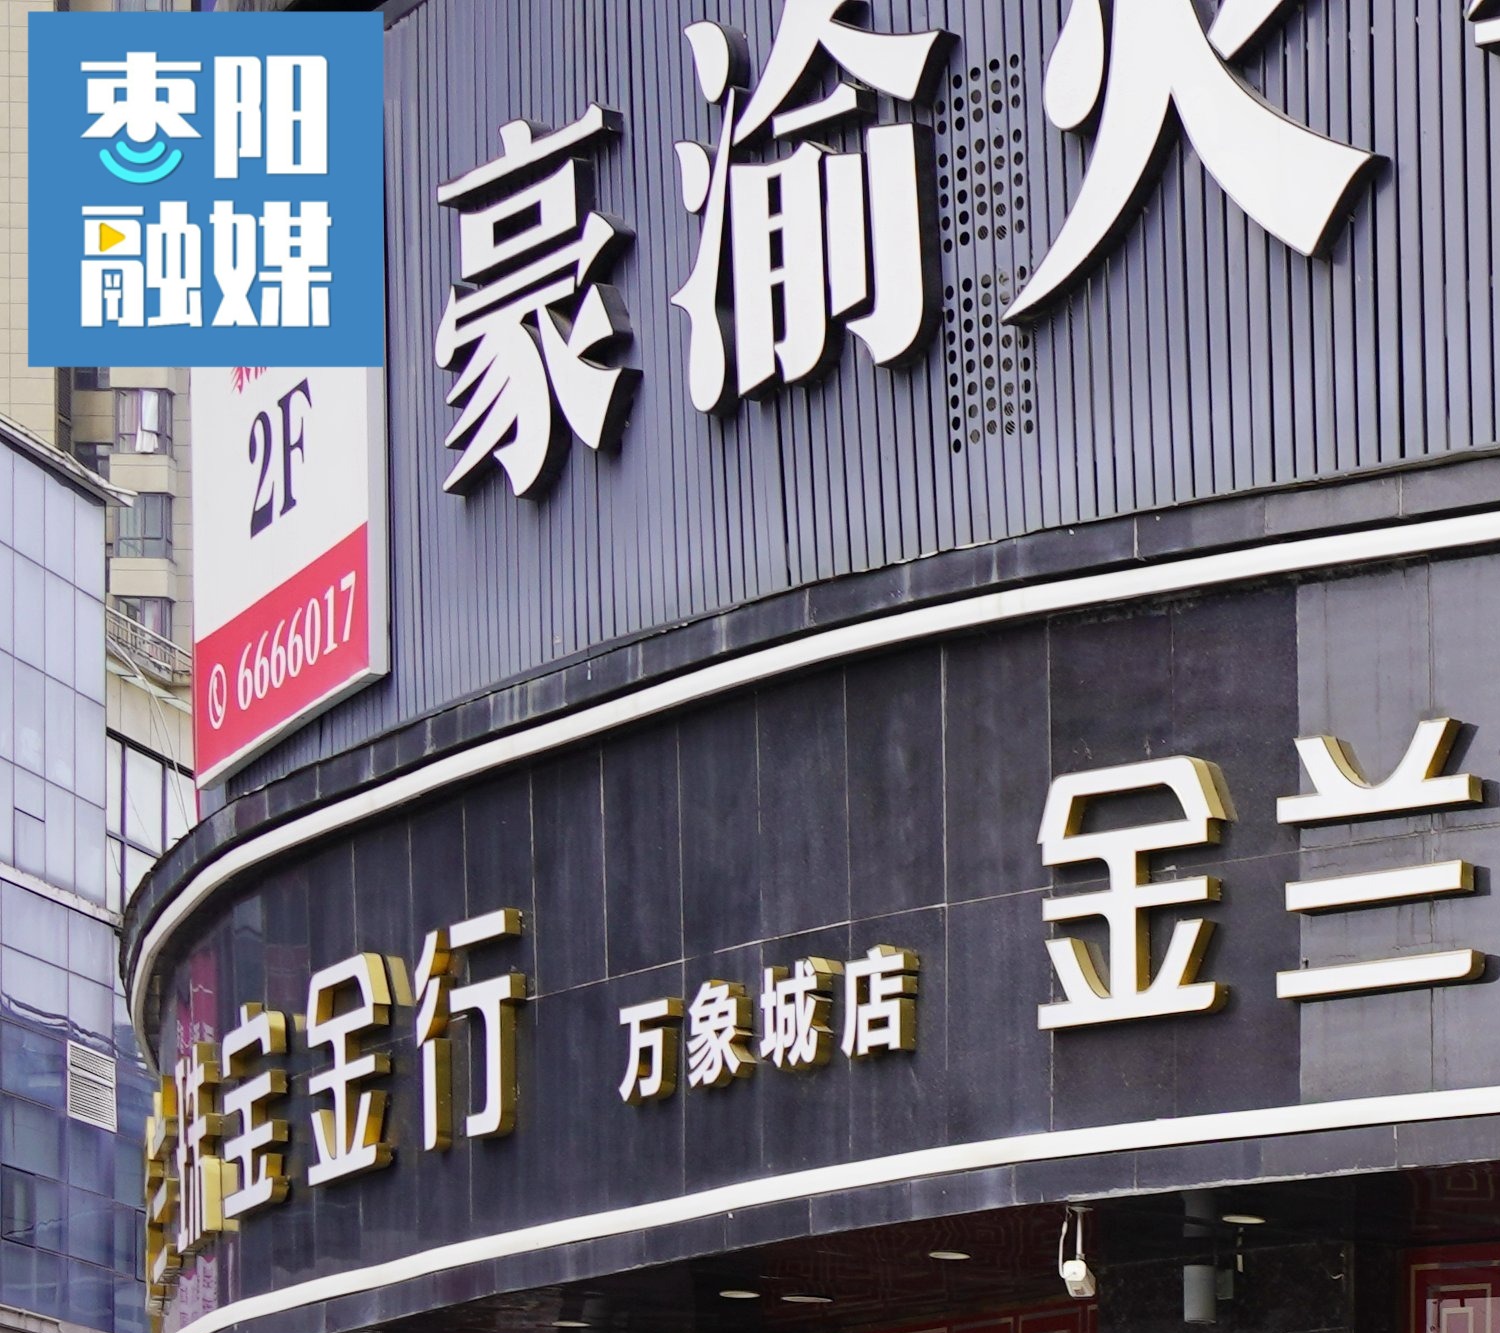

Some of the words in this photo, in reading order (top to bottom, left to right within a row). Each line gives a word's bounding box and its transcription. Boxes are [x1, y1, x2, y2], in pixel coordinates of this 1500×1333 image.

[249, 378, 312, 540] 2F
[237, 570, 356, 712] 6666017
[619, 944, 920, 1104] 万象城店
